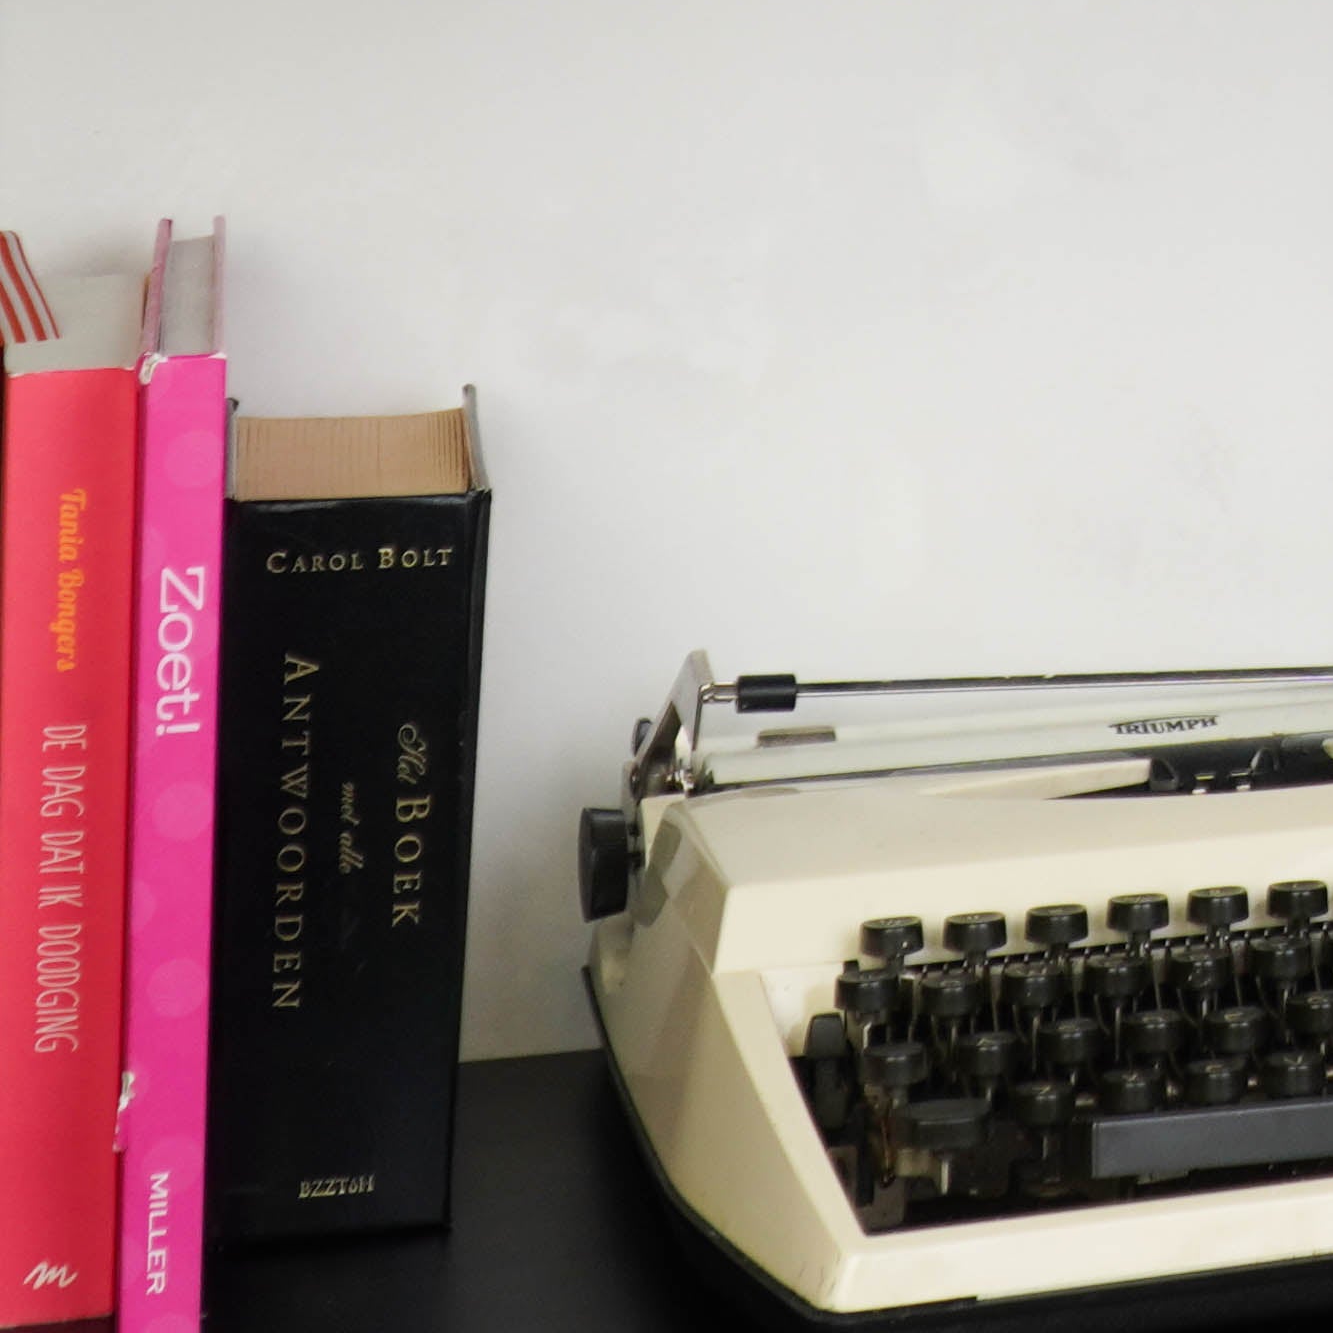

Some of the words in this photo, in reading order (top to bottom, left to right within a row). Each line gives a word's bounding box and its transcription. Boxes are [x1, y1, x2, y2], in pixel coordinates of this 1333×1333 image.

[59, 488, 87, 563] Tania
[266, 550, 364, 574] CAROL
[377, 547, 454, 570] BOLT
[50, 568, 85, 673] Bongers
[155, 565, 206, 738] Zoet!
[42, 724, 88, 752] DE
[1108, 714, 1220, 734] TRIUMPH
[40, 765, 87, 818] DAG
[39, 830, 84, 875] DAT
[272, 652, 320, 1009] ANTWOORDEN
[392, 794, 431, 928] BOEK
[38, 884, 83, 910] IK
[34, 924, 82, 1054] DOODGING
[146, 1171, 170, 1296] MILLER
